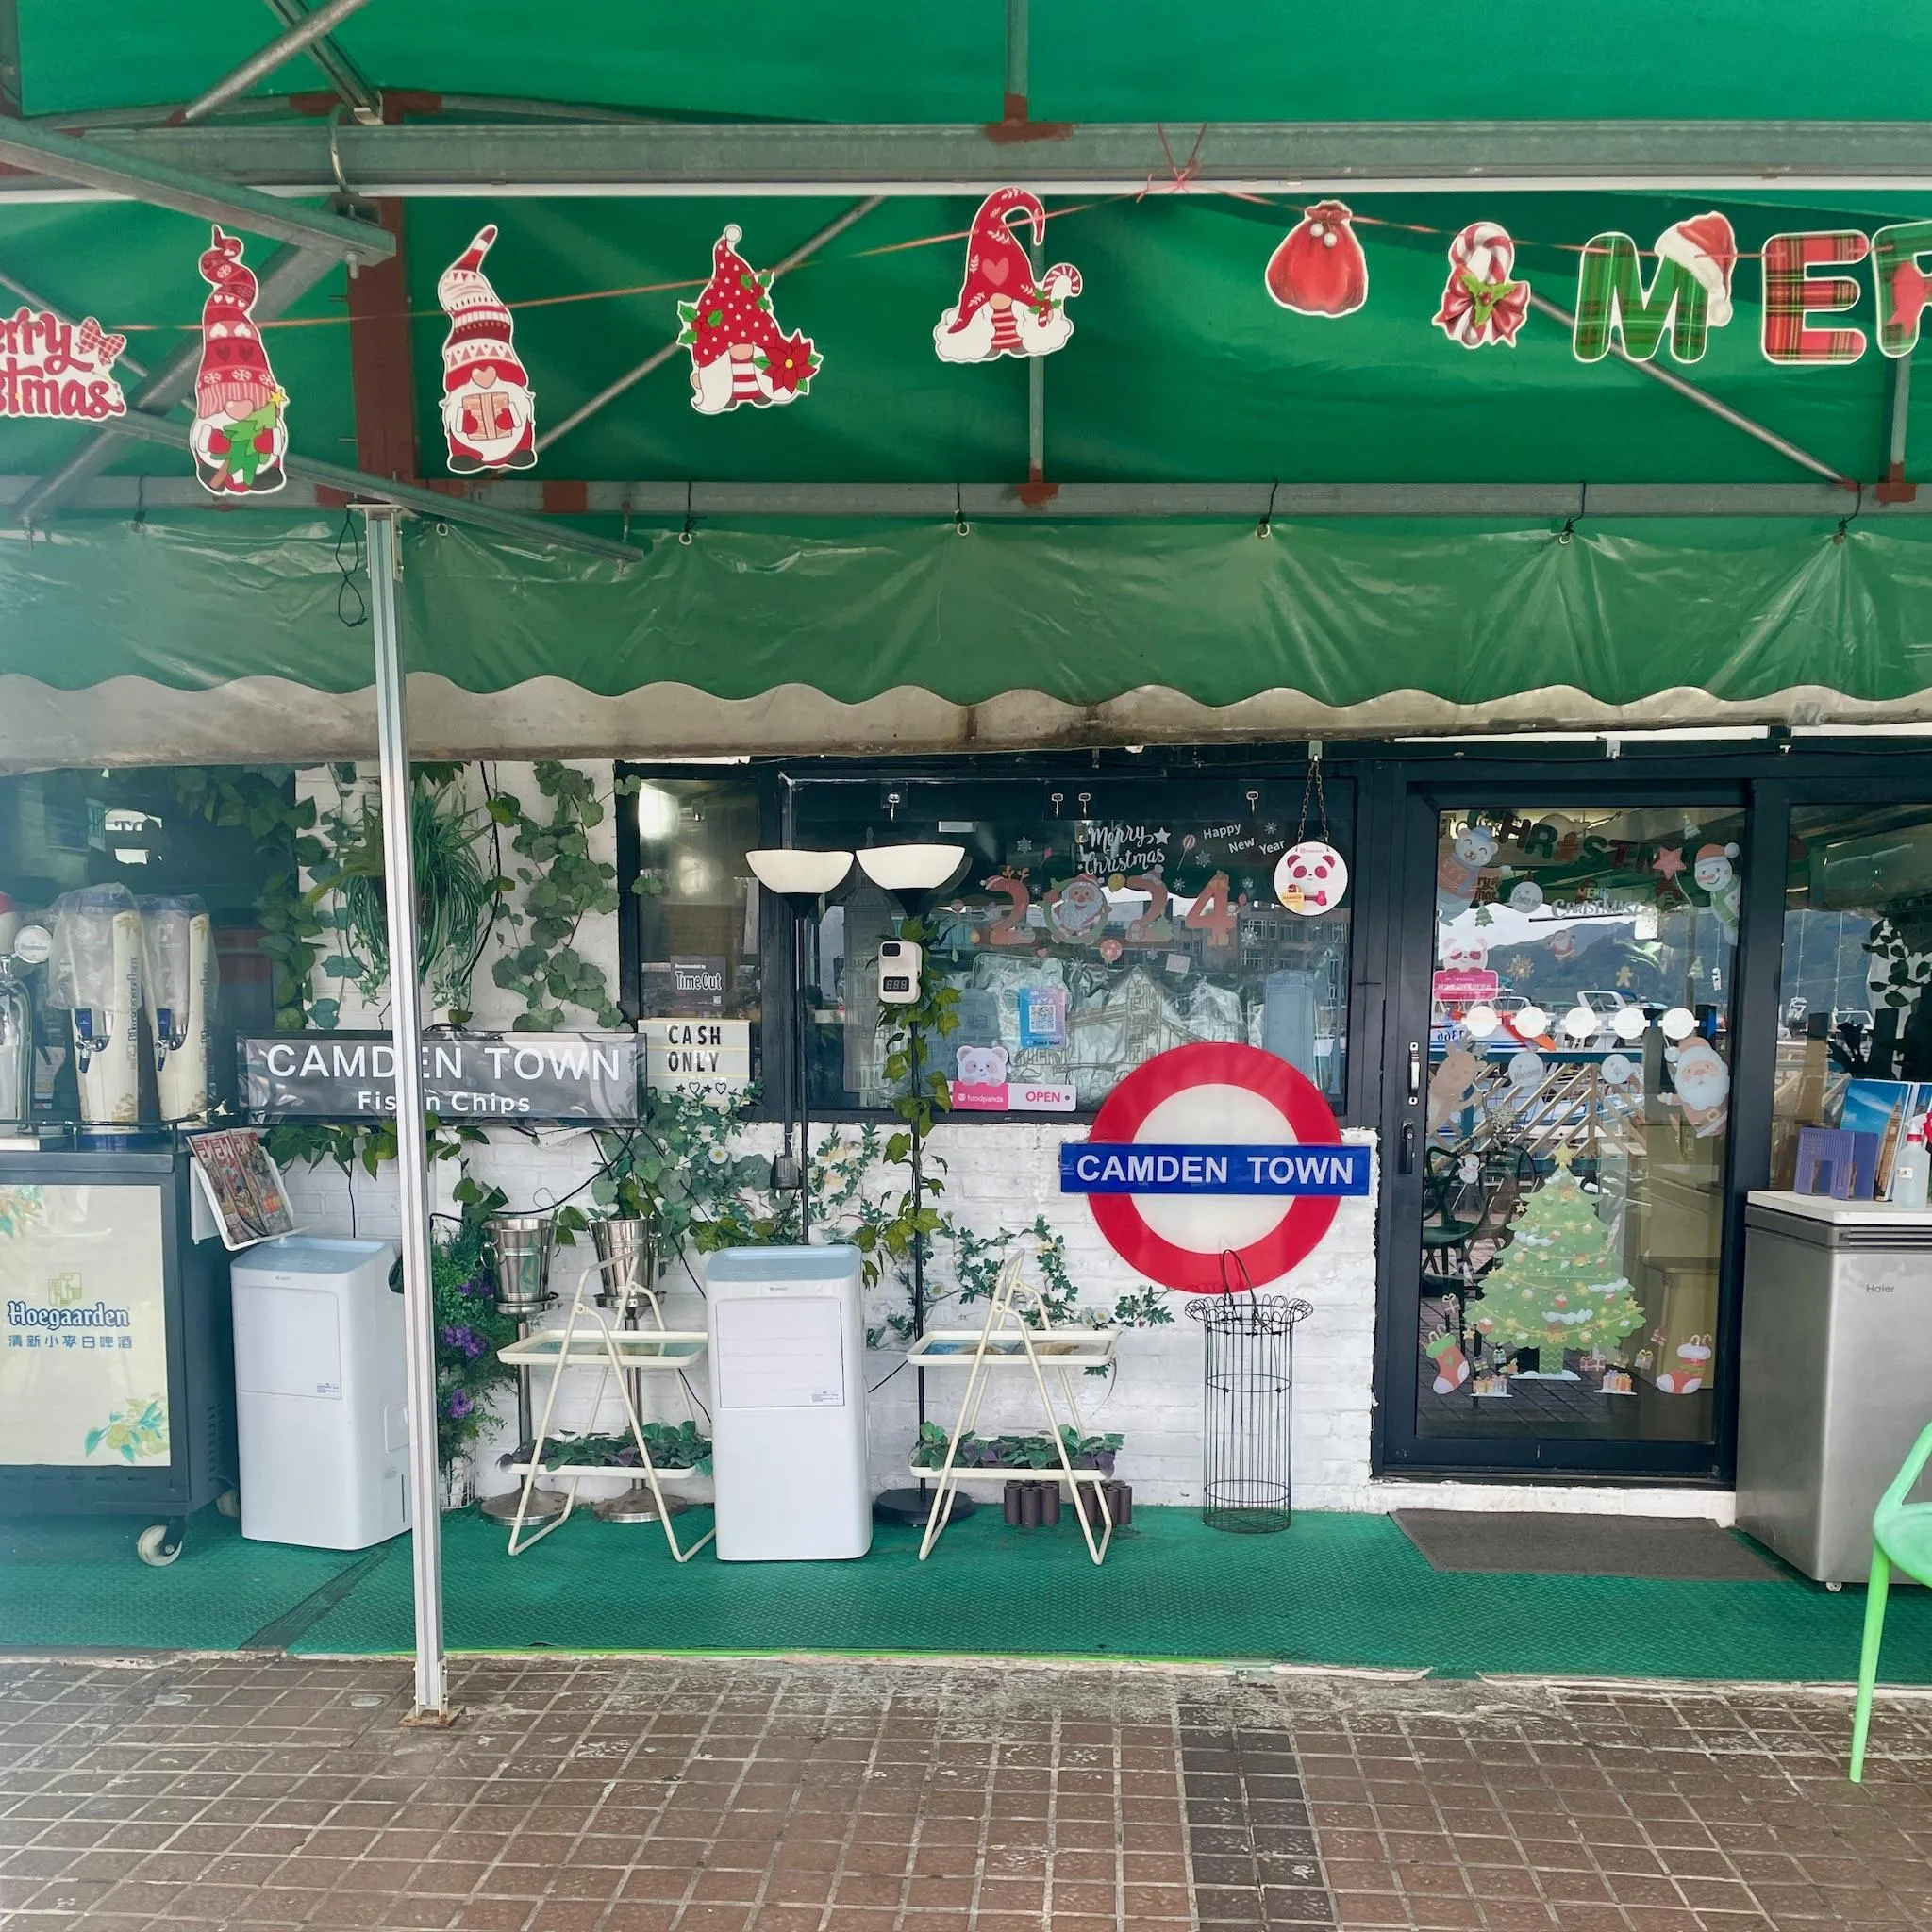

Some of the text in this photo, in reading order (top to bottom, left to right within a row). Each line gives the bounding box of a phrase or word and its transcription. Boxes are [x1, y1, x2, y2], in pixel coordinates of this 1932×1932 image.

[0, 308, 94, 375] rry
[1088, 824, 1154, 854] Merry
[1203, 823, 1241, 840] Happy
[1228, 837, 1286, 855] New Year
[1083, 847, 1165, 875] Christmas
[668, 1025, 721, 1045] CASH
[484, 1047, 620, 1081] TOWN
[668, 1051, 720, 1072] ONLY
[358, 1091, 397, 1111] Fis
[451, 1091, 531, 1115] Chips
[967, 1094, 1004, 1103] foodpanda
[1025, 1091, 1061, 1103] OPEN
[1076, 1155, 1355, 1185] CAMDEN TOWN
[1866, 1284, 1895, 1293] Haier
[8, 1300, 131, 1330] Hoegaarden
[8, 1334, 133, 1349] 清新小麥白啤酒
